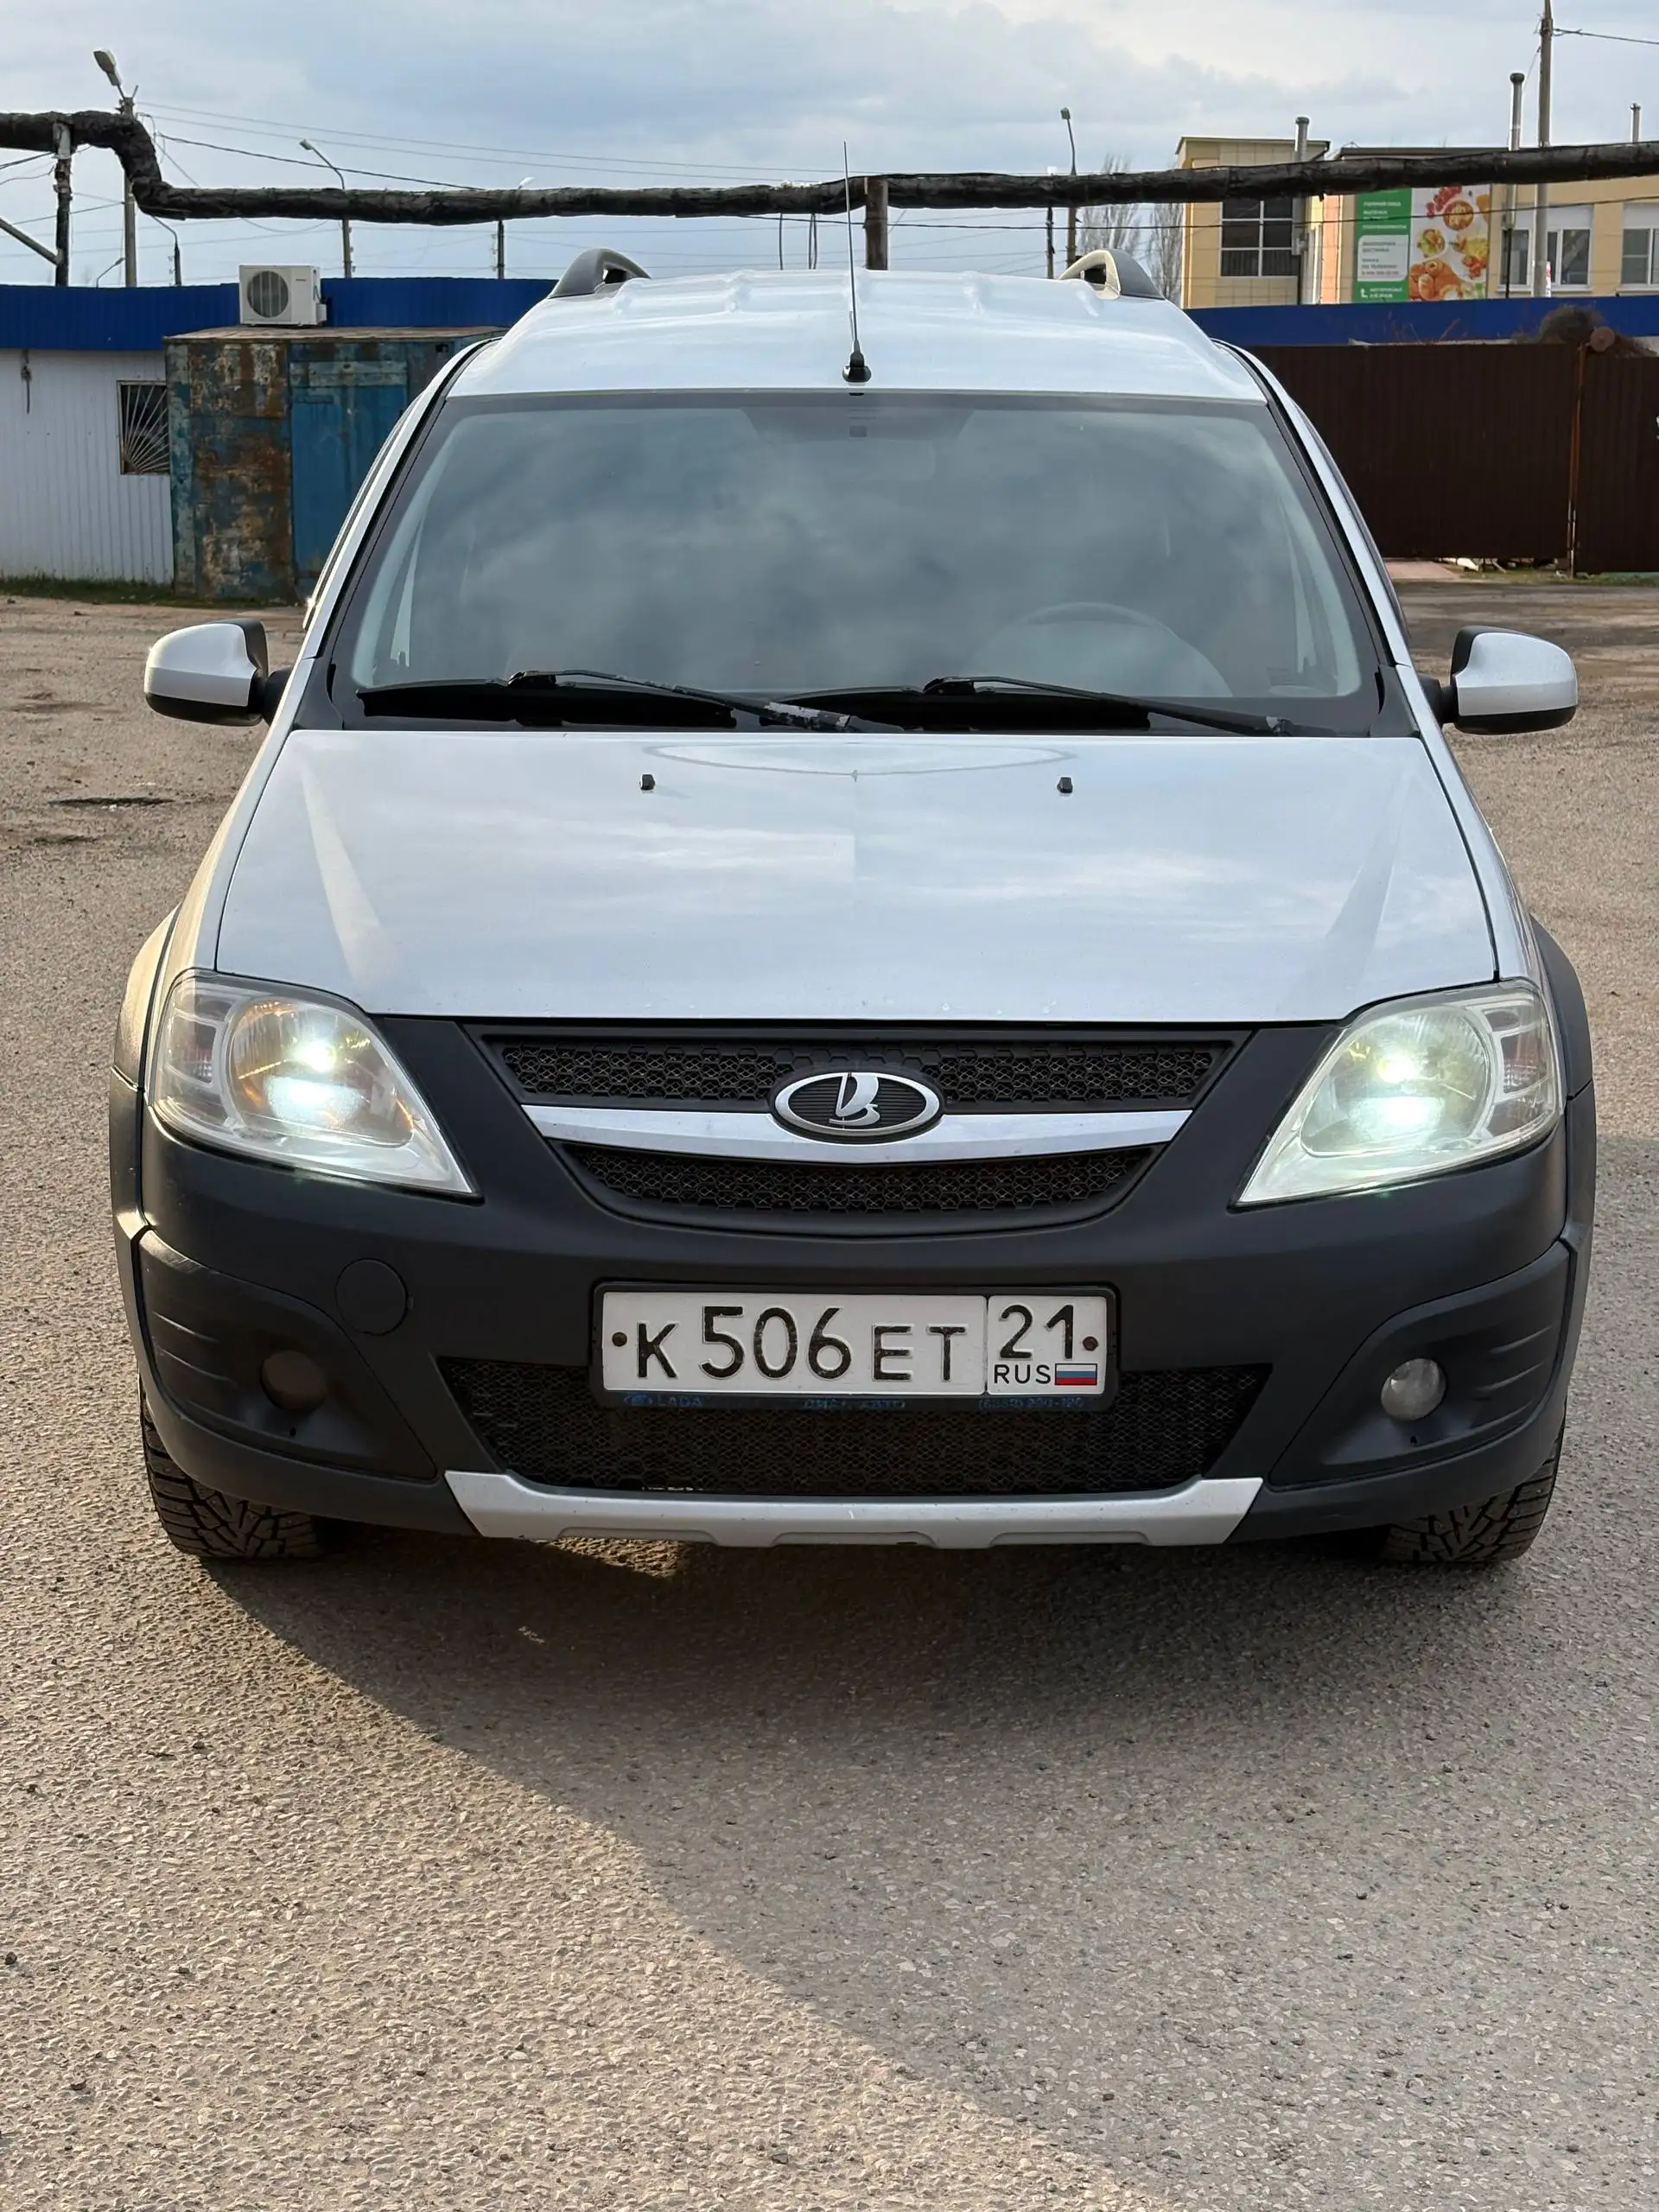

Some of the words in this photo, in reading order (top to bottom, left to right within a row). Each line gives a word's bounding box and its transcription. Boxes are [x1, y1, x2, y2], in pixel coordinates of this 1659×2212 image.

[698, 1306, 852, 1381] 506
[999, 1304, 1074, 1360] 21
[993, 1363, 1052, 1385] RUS
[658, 1394, 703, 1408] LADA
